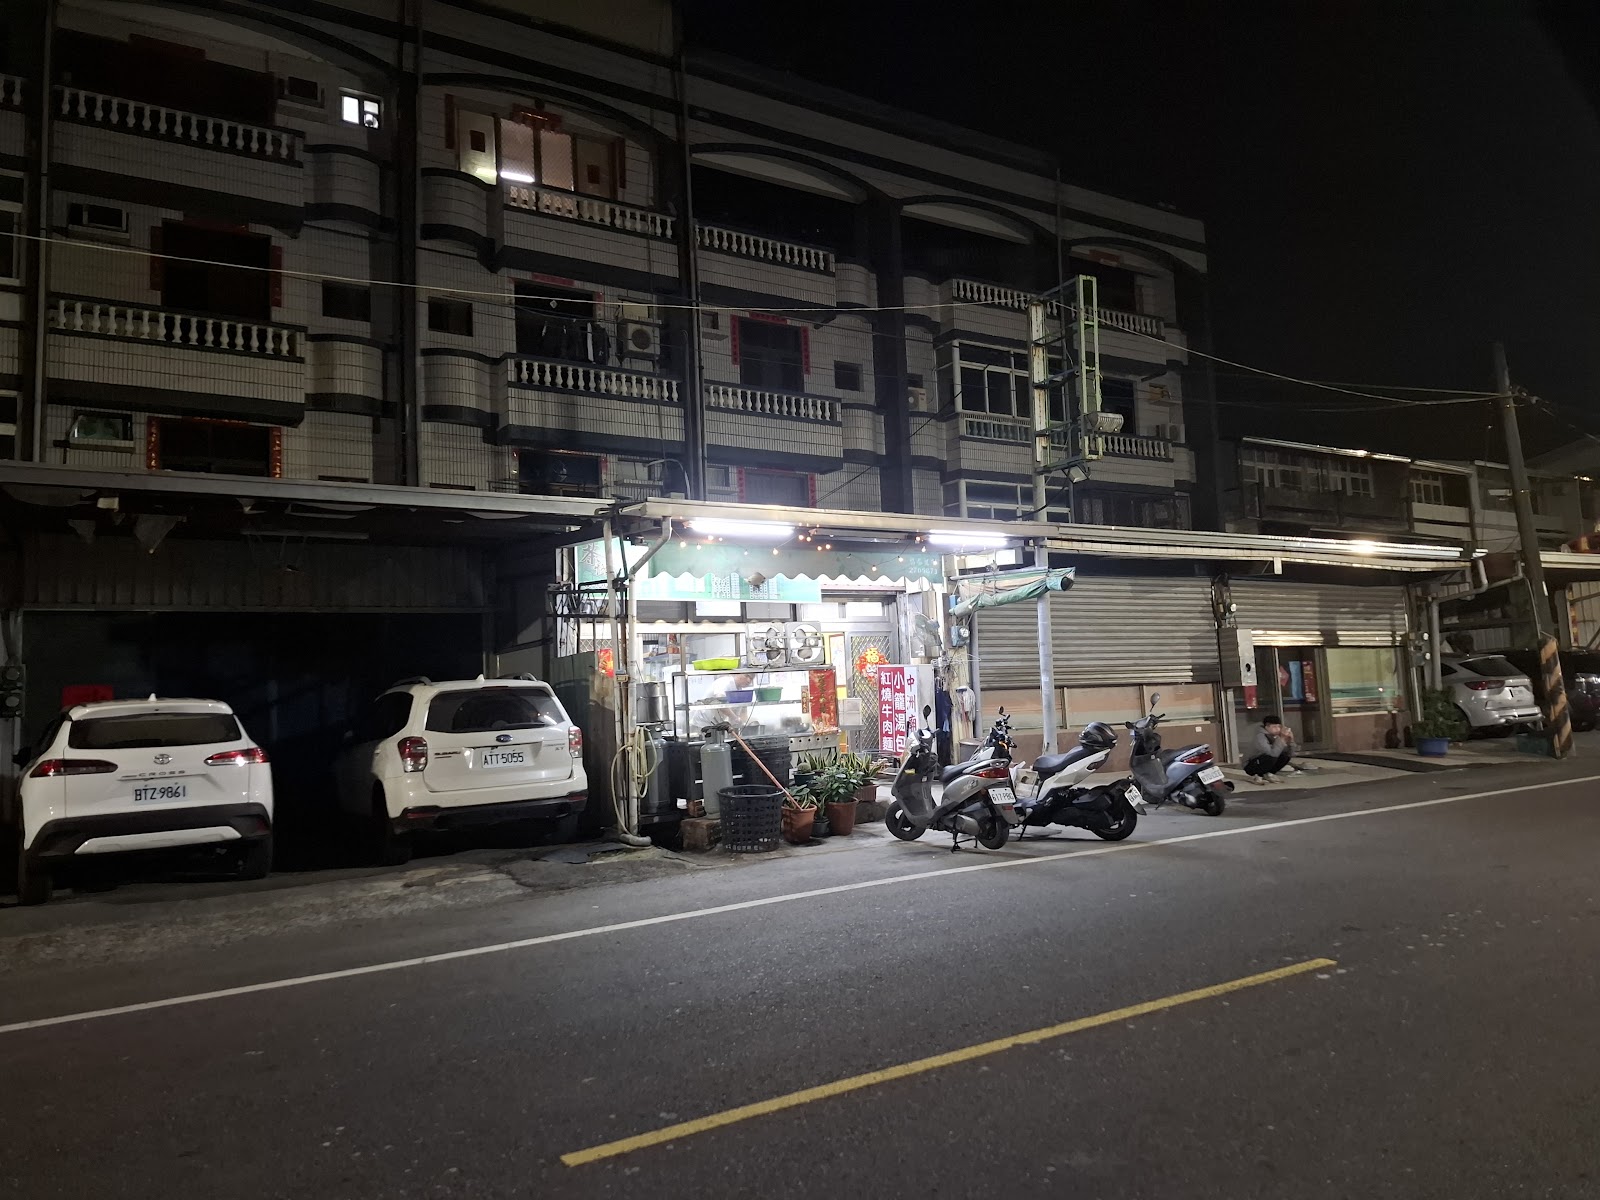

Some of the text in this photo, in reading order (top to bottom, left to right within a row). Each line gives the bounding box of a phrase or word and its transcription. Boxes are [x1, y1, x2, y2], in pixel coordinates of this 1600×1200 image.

[865, 647, 880, 663] 福
[880, 671, 894, 751] 紅燒牛肉麵
[893, 671, 906, 752] 小籠湯包
[483, 751, 524, 765] ATT-5055
[134, 785, 186, 801] BTZ-9861
